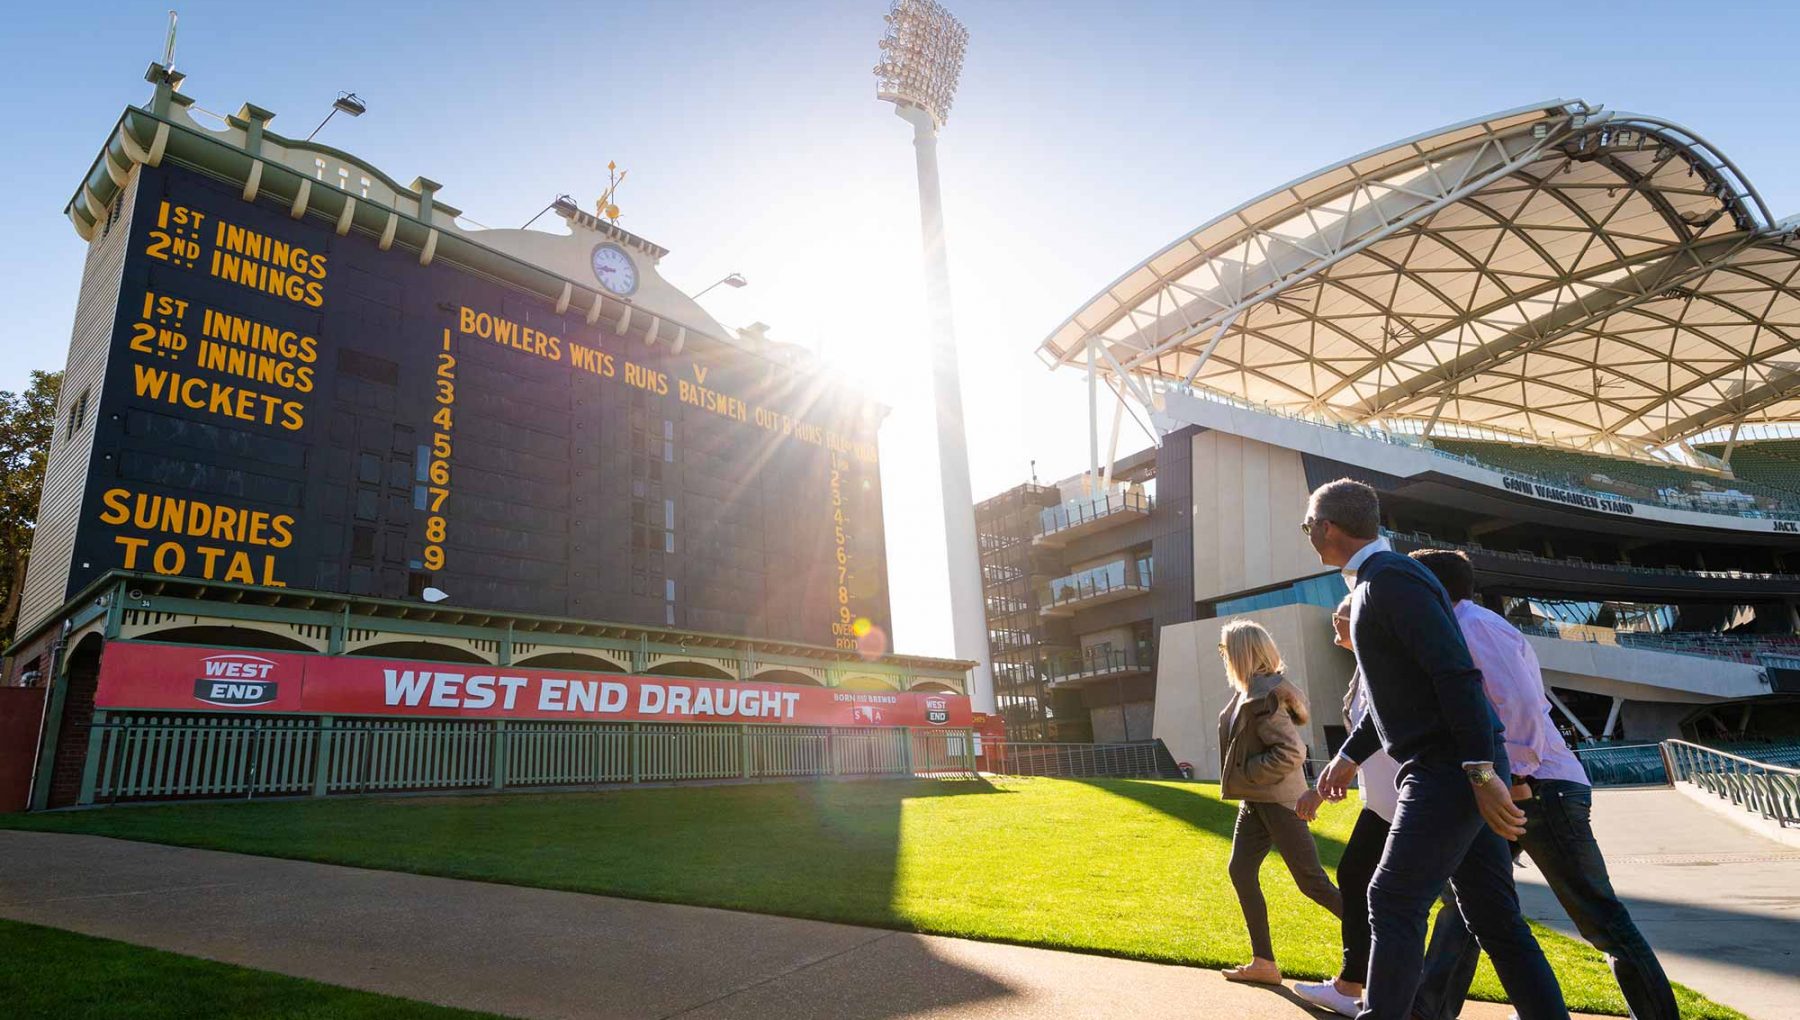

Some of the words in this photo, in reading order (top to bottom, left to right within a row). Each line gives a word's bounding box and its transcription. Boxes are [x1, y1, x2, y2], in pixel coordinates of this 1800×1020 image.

[157, 201, 204, 239] 1ST
[216, 221, 327, 279] INNINGS
[146, 231, 200, 269] 2ND
[211, 250, 323, 307] INNINGS
[142, 292, 188, 327] 1ST
[203, 309, 318, 363] INNINGS
[443, 328, 451, 352] 1
[130, 323, 187, 359] 2ND
[197, 340, 314, 393] INNINGS
[437, 353, 456, 379] 2
[460, 307, 561, 360] BOWLERS
[570, 343, 615, 377] WKTS
[625, 362, 669, 395] RUNS
[679, 380, 747, 422] BATSMEN
[755, 407, 779, 431] OUT
[693, 363, 708, 384] V
[134, 364, 304, 431] WICKETS
[436, 379, 455, 405] 3
[433, 407, 453, 431] 4
[433, 432, 452, 458] 5
[429, 459, 449, 486] 6
[831, 470, 839, 487] 2
[429, 487, 449, 513] 7
[832, 489, 842, 505] 3
[1502, 476, 1533, 496] GAVIN
[1534, 484, 1599, 509] WANGANEEN
[1600, 500, 1634, 515] STAND
[100, 488, 295, 548] SUNDRIES
[833, 508, 843, 525] 4
[1773, 521, 1798, 532] JACK
[425, 516, 446, 543] 8
[835, 527, 844, 545] 5
[115, 536, 287, 588] TOTAL
[424, 545, 445, 571] 9
[836, 547, 846, 565] 6
[838, 566, 847, 584] 7
[839, 586, 849, 604] 8
[840, 606, 851, 624] 9
[206, 661, 274, 678] WEST
[210, 683, 265, 700] END
[384, 669, 529, 710] WEST
[538, 678, 629, 714] END
[638, 683, 801, 719] DRAUGHT
[834, 693, 855, 702] BORN
[854, 710, 861, 720] S
[926, 700, 945, 709] WEST
[930, 712, 946, 721] END
